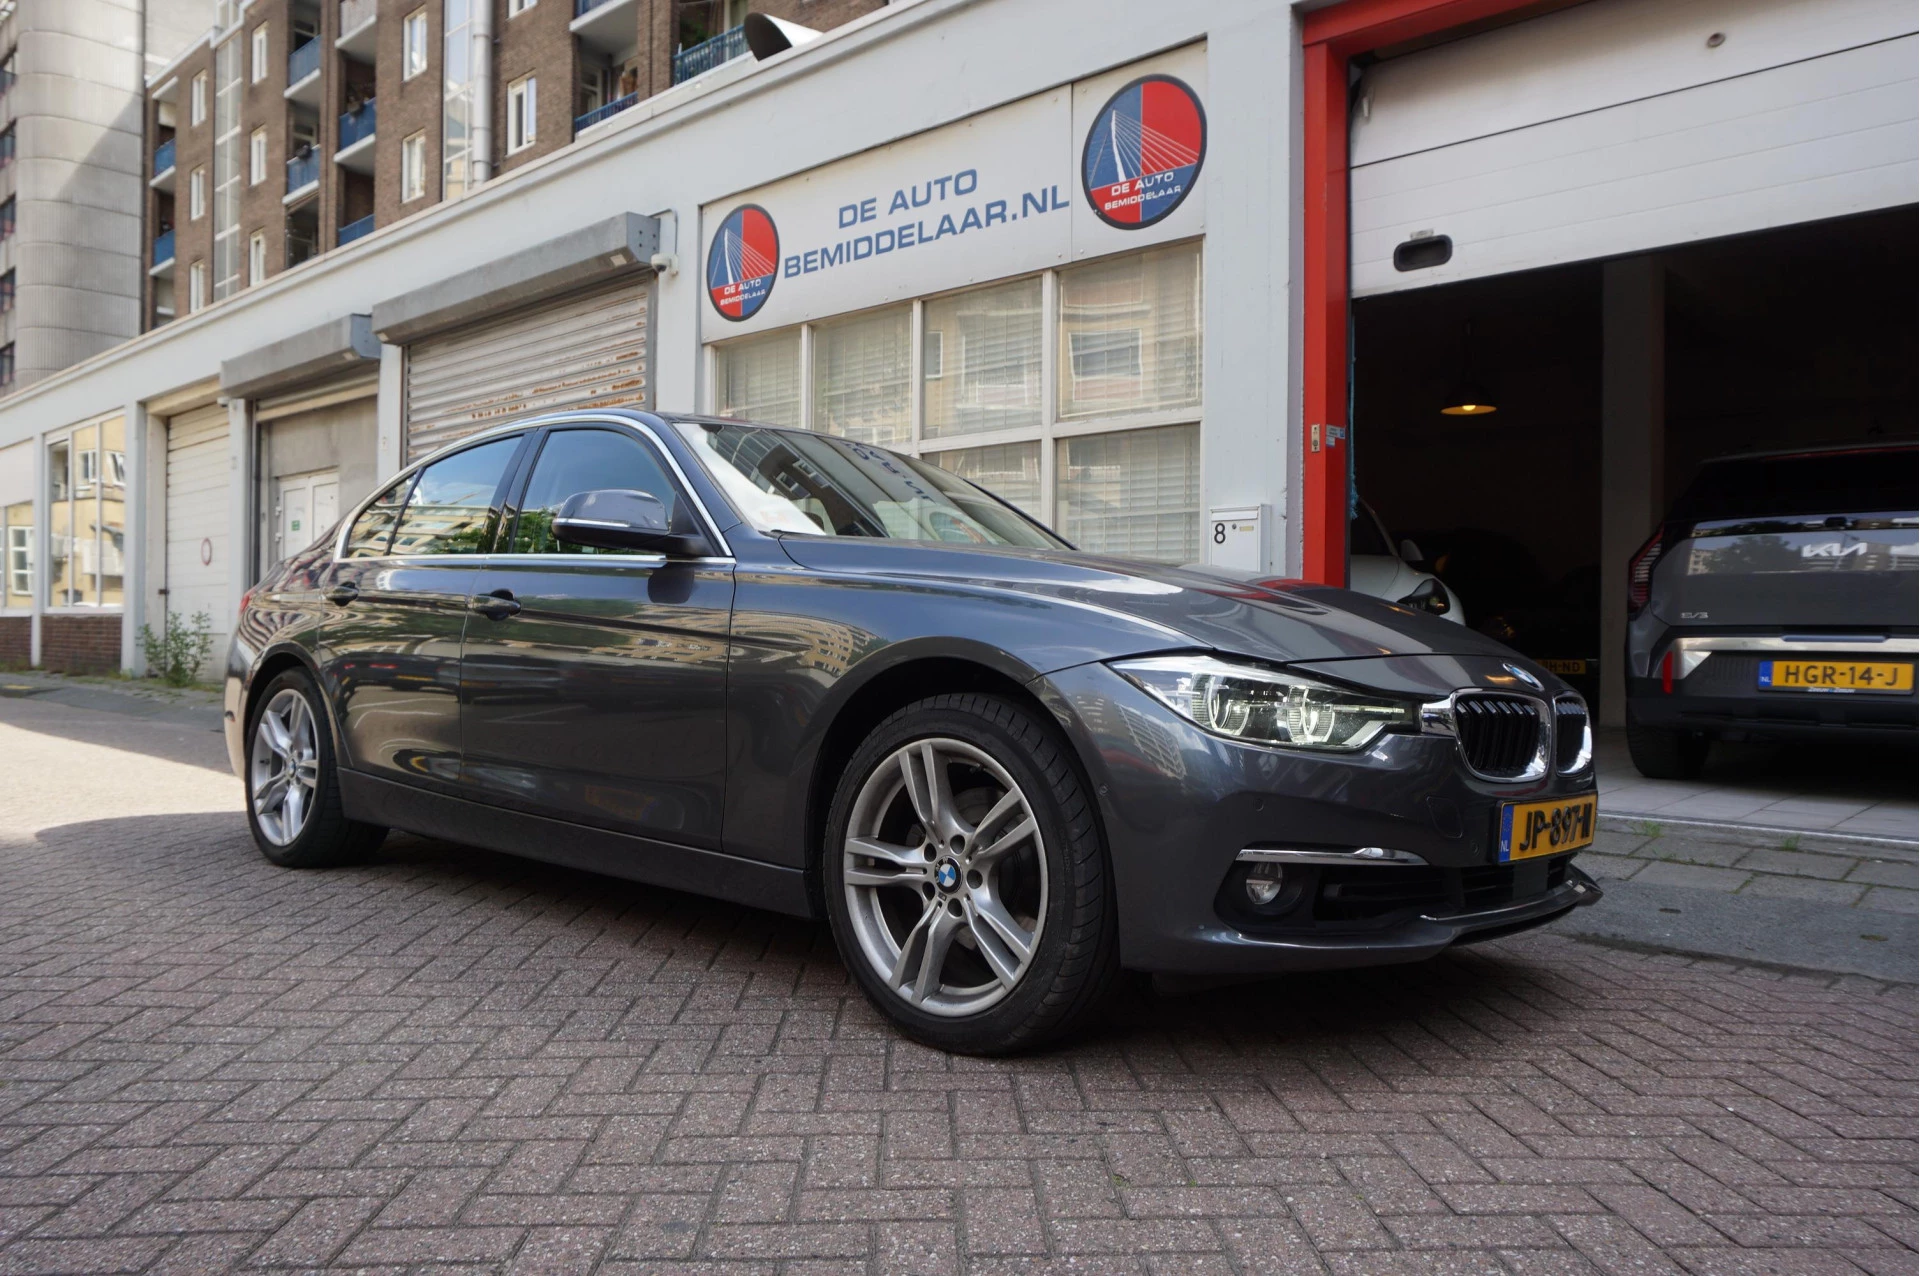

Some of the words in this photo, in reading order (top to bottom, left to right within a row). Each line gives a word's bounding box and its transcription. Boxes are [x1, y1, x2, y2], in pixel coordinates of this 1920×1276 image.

[1111, 182, 1130, 196] DE
[1134, 171, 1174, 191] AUTO
[838, 197, 877, 229] DE
[888, 169, 977, 215] AUTO
[1104, 185, 1181, 211] BEMIDDELAAR
[784, 185, 1070, 279] BEMIDDELAAR.NL
[720, 289, 766, 306] BEMIDDELAAR
[724, 285, 736, 295] DE
[738, 278, 761, 291] AUTO
[1214, 522, 1226, 544] 8
[1784, 665, 1898, 686] HGR-14-J
[1500, 840, 1509, 852] NL
